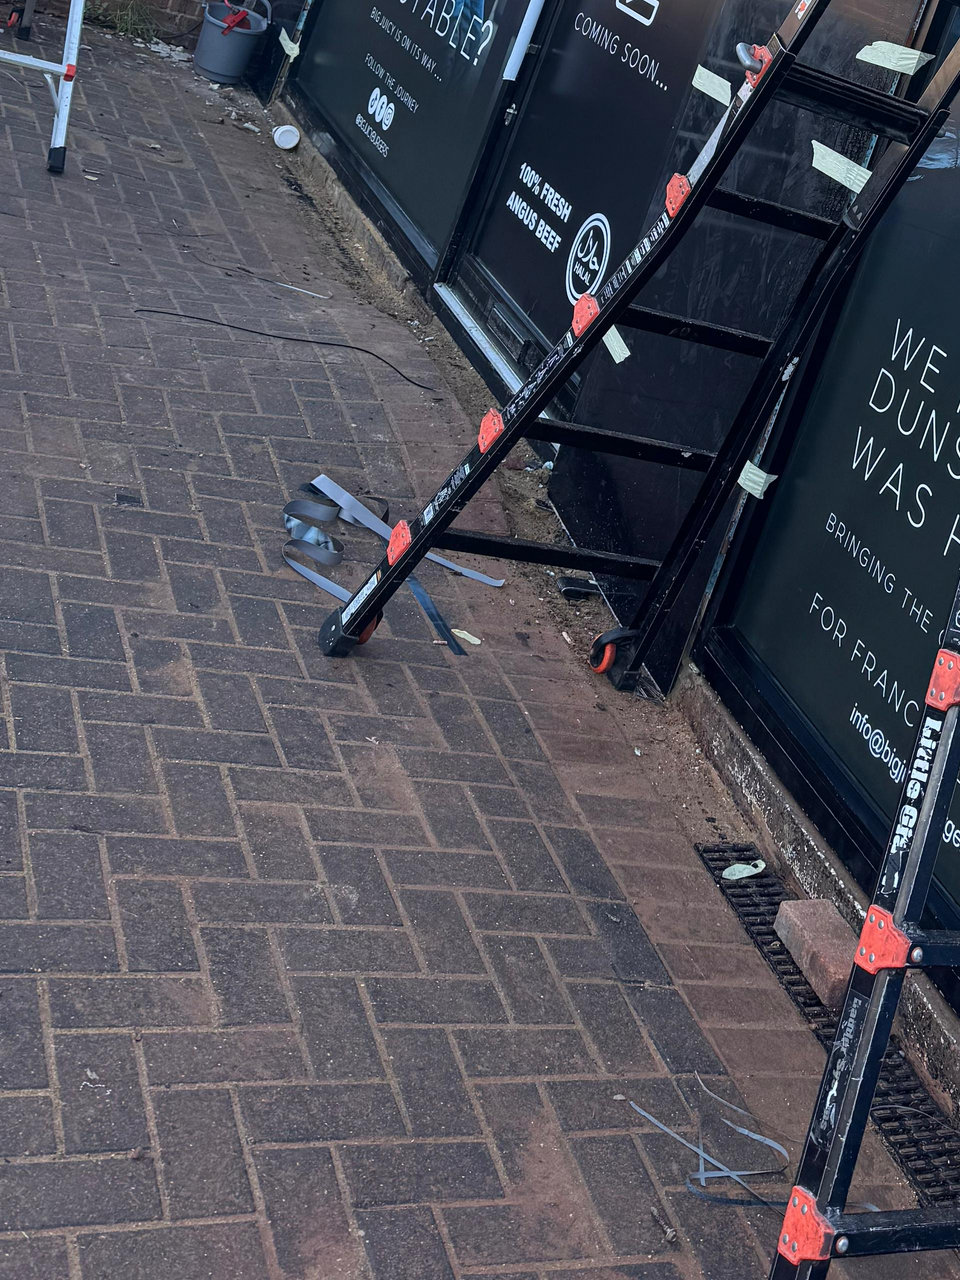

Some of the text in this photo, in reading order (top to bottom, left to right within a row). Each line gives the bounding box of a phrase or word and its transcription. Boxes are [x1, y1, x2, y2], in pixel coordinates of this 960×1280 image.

[370, 6, 382, 23] BIG
[379, 15, 397, 36] JUICY
[394, 28, 403, 42] IS
[401, 35, 412, 51] ON
[410, 42, 422, 60] ITS
[574, 12, 668, 91] COMING SOON...
[364, 53, 420, 113] FOLLOW THE JOURNEY
[506, 191, 562, 253] ANGUS BEEF
[519, 162, 572, 223] 100% FRESH
[573, 261, 591, 286] HALAL
[891, 318, 948, 393] WE
[852, 426, 933, 528] WAS
[825, 512, 934, 634] BRINGING THE
[809, 592, 848, 648] FOR
[906, 716, 943, 800] Little
